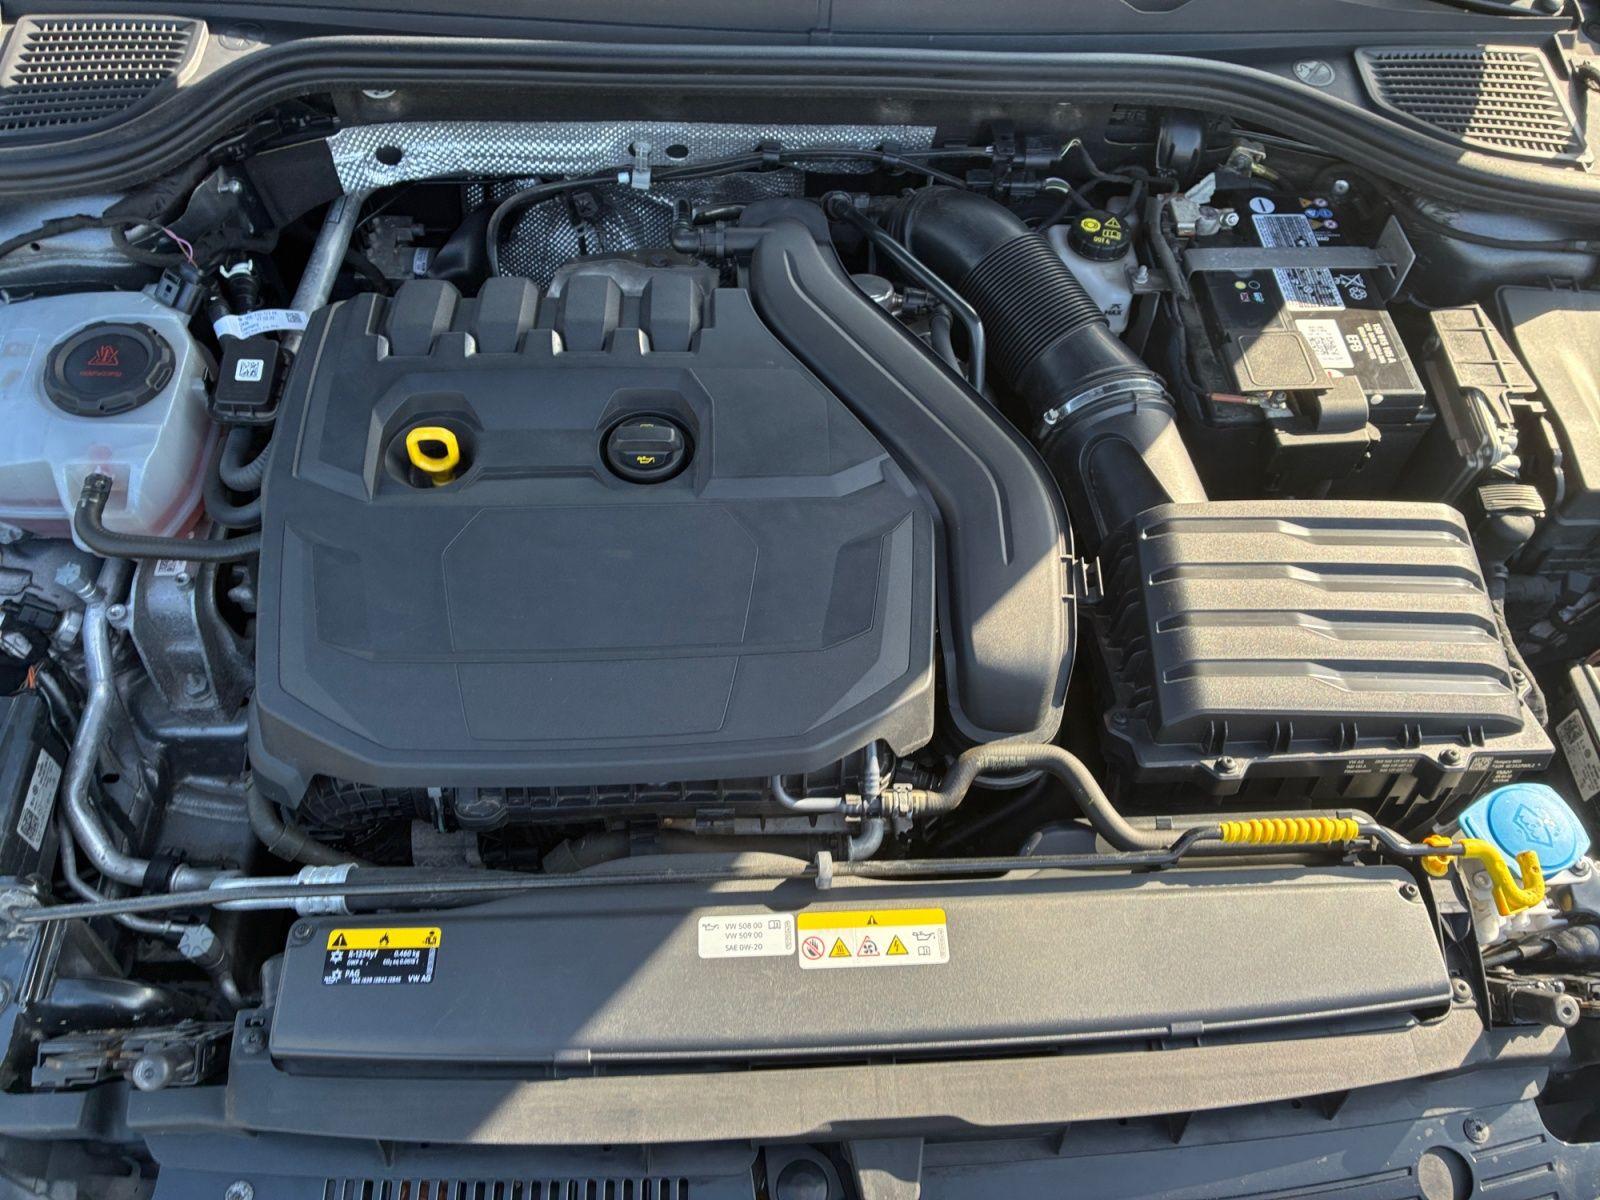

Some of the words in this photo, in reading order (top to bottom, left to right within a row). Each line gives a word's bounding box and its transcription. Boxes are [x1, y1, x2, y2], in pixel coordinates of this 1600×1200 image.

[1345, 335, 1364, 352] EFB
[739, 922, 752, 930] 508
[725, 932, 738, 940] VW
[739, 932, 752, 940] 509
[753, 931, 763, 939] 00
[725, 944, 738, 952] SAE
[739, 943, 763, 952] 0W-20
[345, 969, 360, 978] PAG
[408, 974, 420, 983] VW
[420, 974, 432, 983] AG
